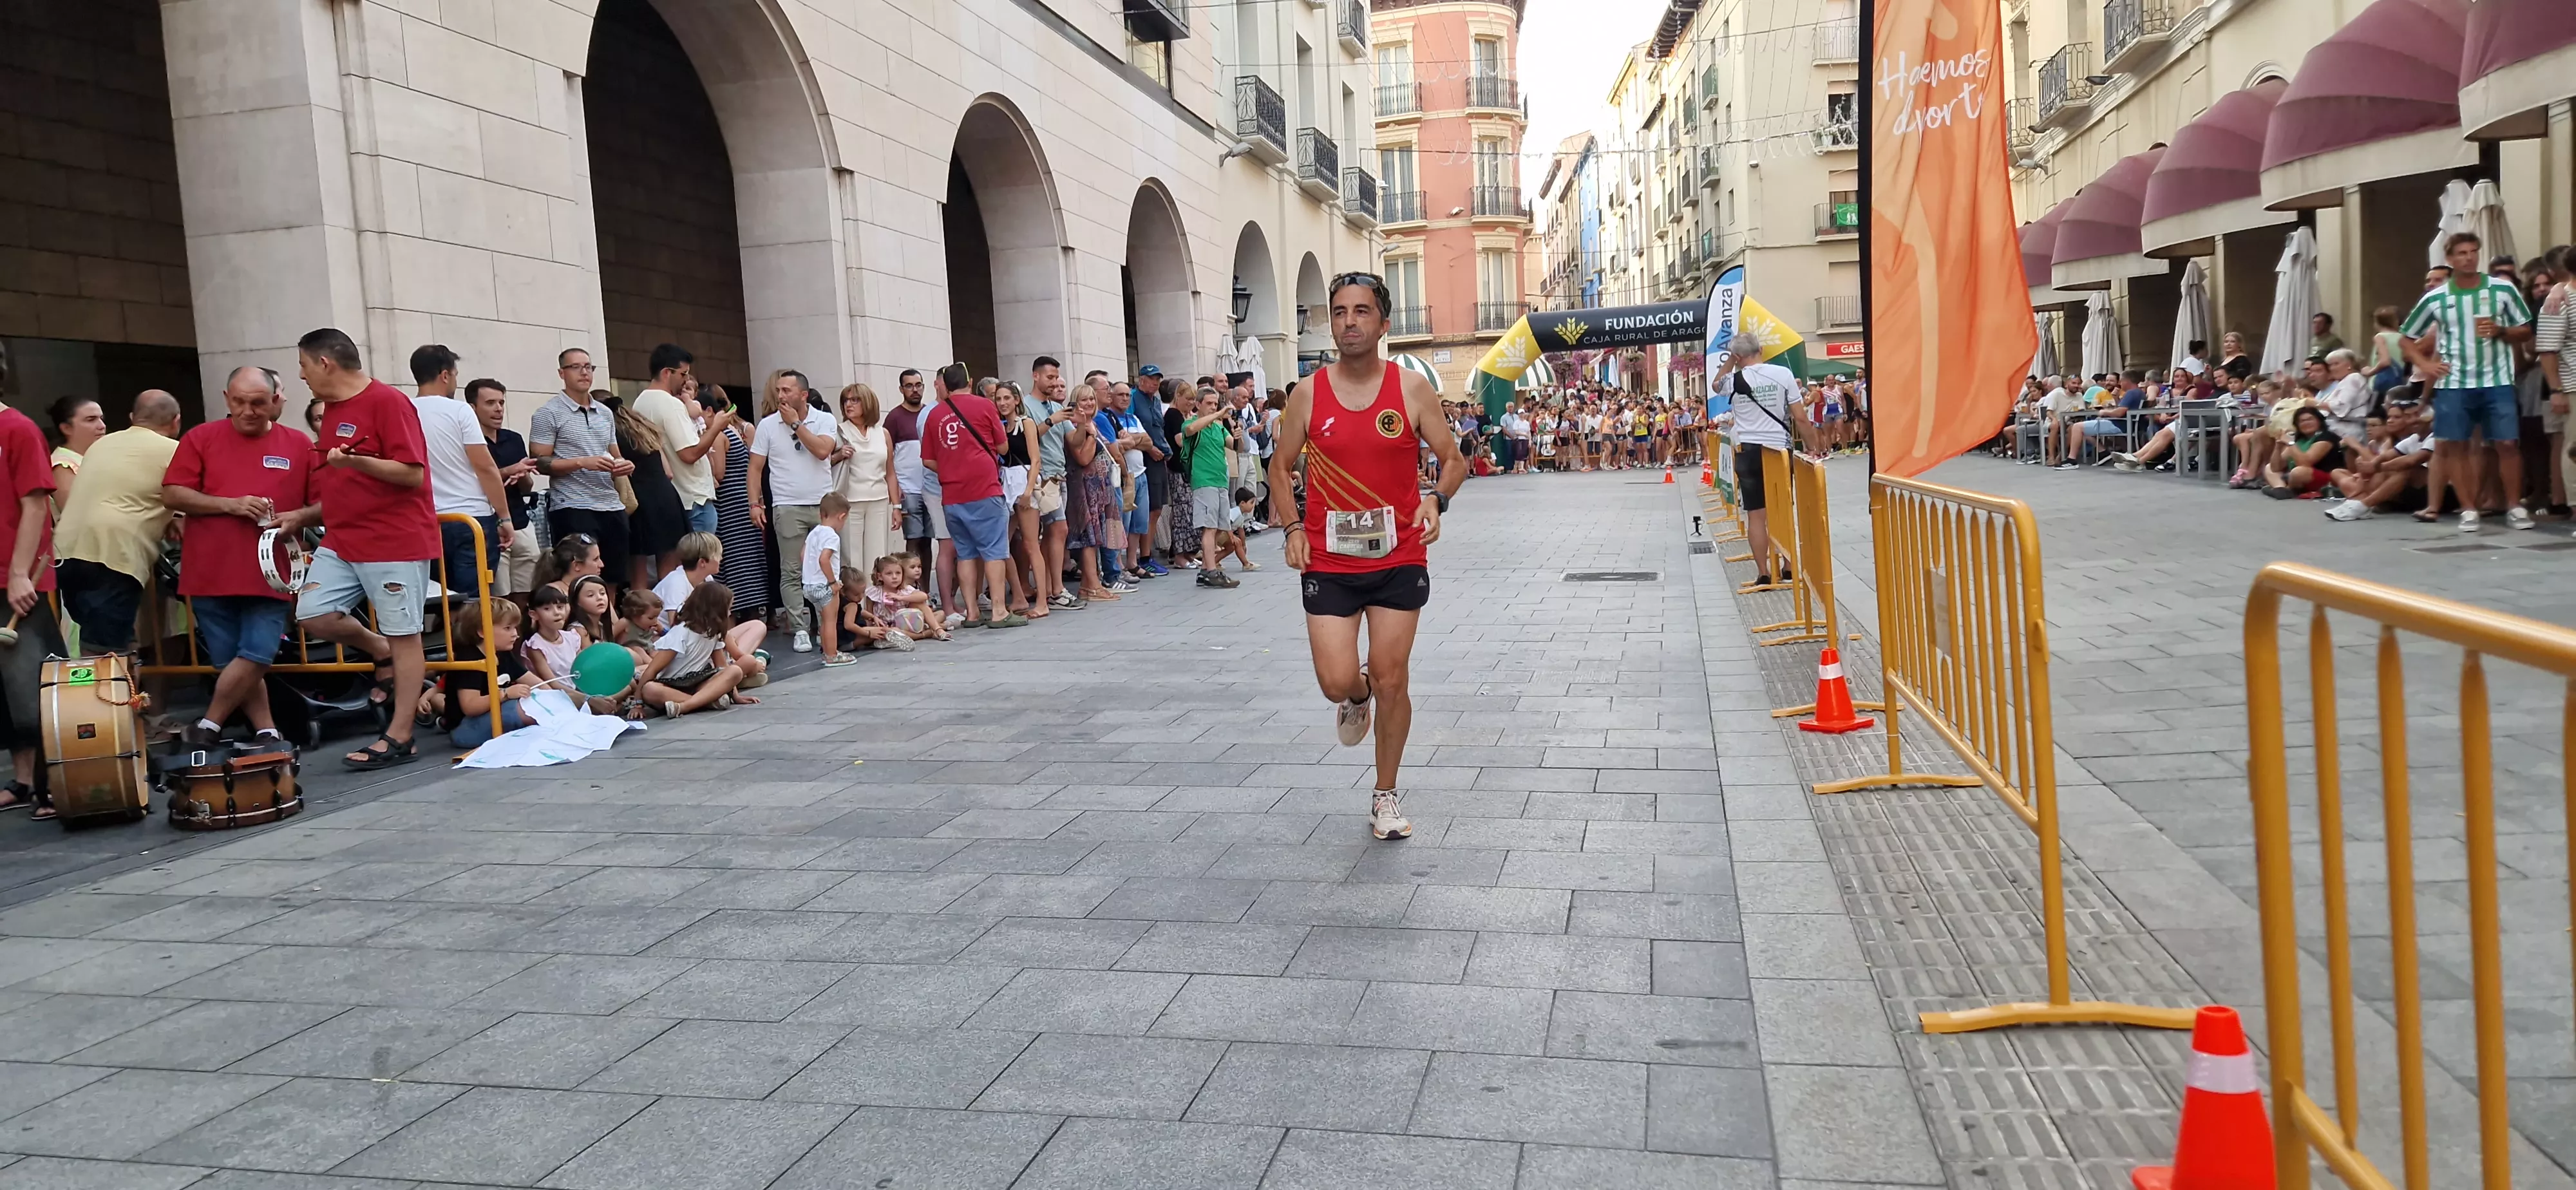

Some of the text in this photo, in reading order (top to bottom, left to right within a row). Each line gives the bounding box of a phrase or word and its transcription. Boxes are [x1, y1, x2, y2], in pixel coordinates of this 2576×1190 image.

[1605, 309, 1694, 330] FUNDACIÓN
[1584, 335, 1611, 345] CAJA
[1615, 332, 1650, 341] RURAL
[1841, 344, 1864, 354] GAES
[1347, 511, 1374, 529] 14
